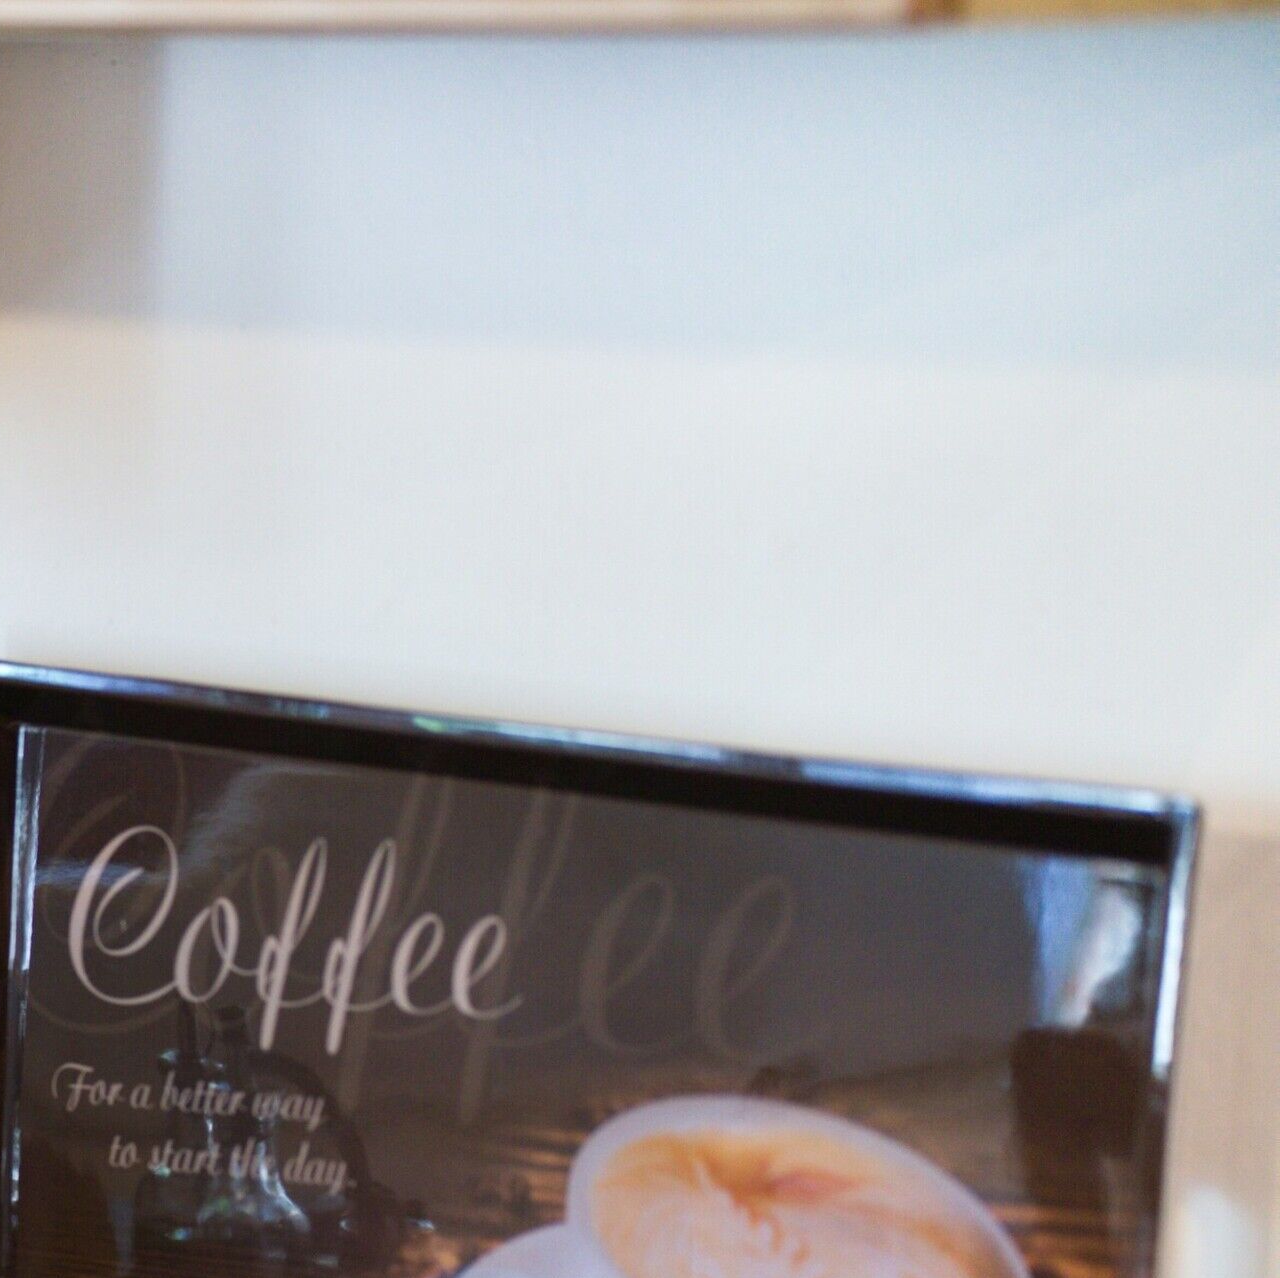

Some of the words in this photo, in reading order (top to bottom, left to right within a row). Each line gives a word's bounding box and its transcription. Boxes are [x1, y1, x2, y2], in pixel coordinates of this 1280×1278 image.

[67, 824, 524, 1056] Coffee
[51, 1062, 124, 1112] For
[130, 1083, 151, 1110] a
[159, 1070, 246, 1116] better
[250, 1094, 325, 1132] way
[108, 1135, 139, 1169] to
[146, 1139, 223, 1177] start
